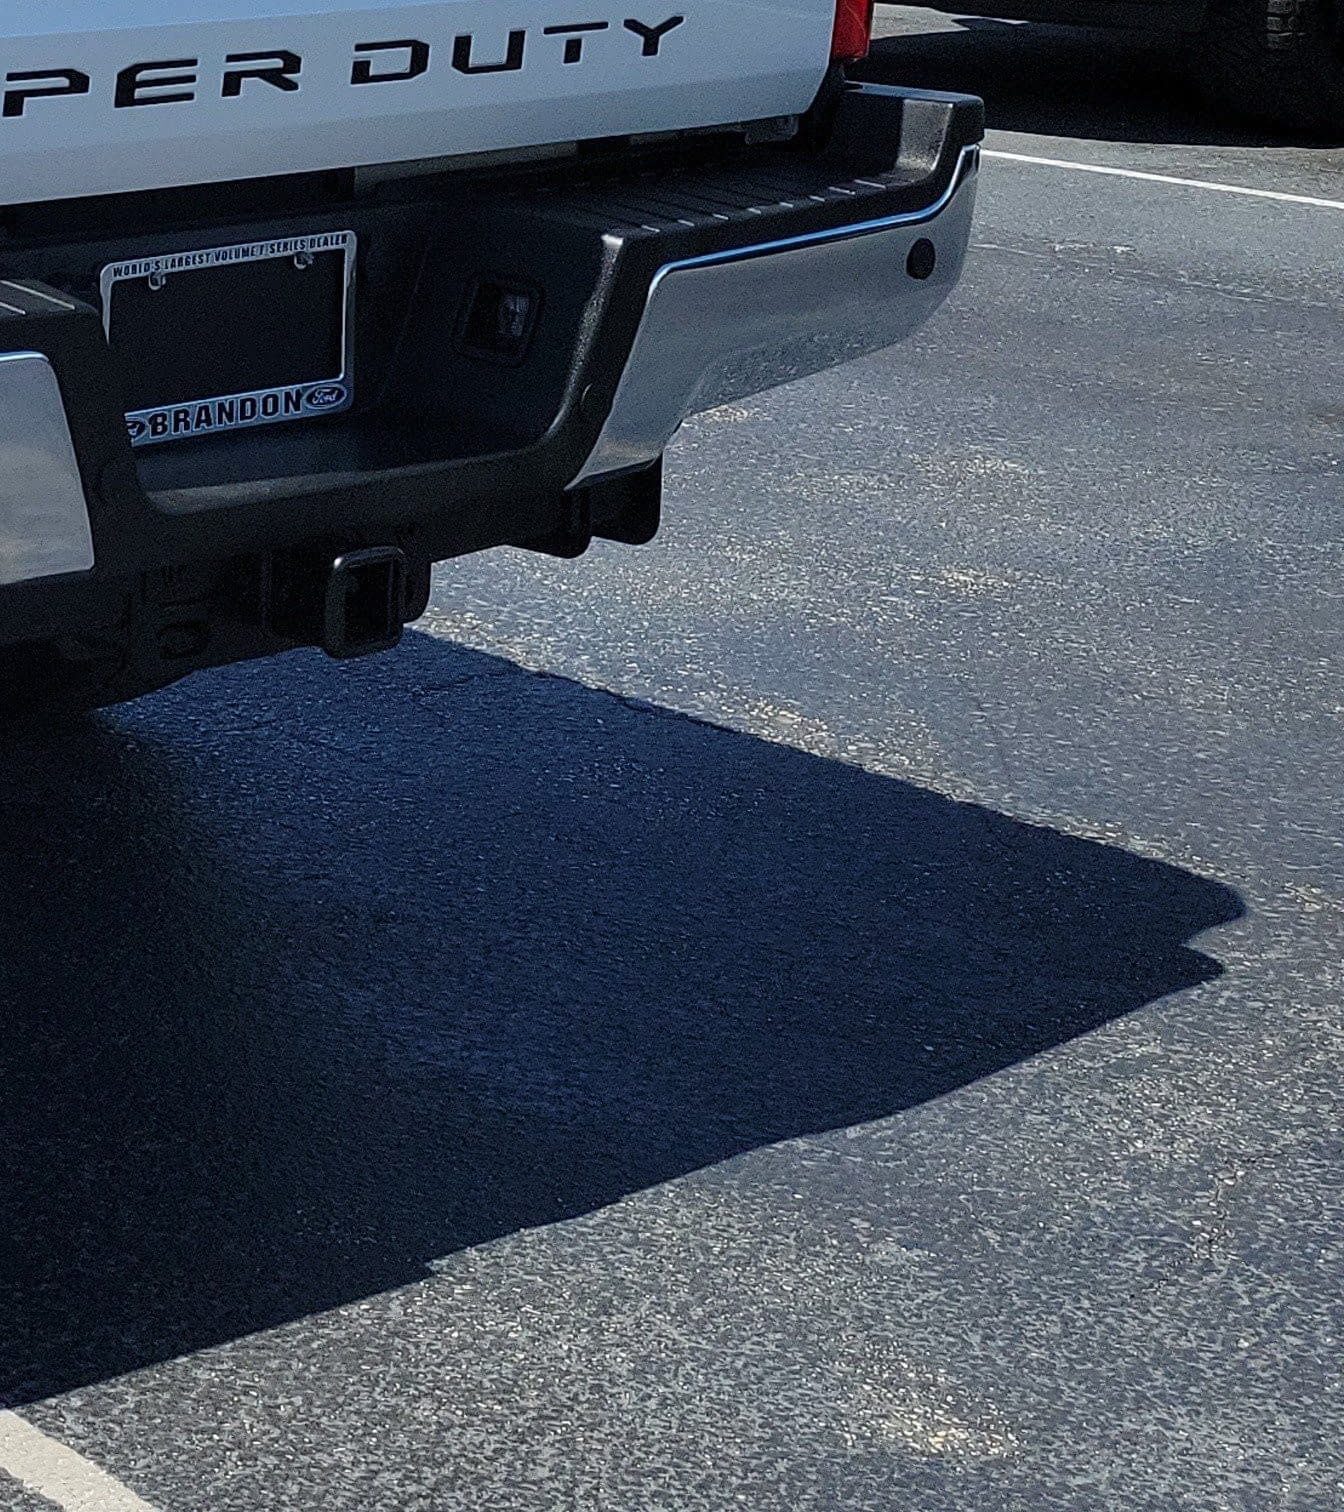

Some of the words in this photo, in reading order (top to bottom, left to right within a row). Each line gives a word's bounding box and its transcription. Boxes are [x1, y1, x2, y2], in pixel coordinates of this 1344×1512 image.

[349, 15, 684, 85] DUTY
[164, 253, 211, 269] LARGEST
[214, 245, 256, 261] VOLUME
[309, 234, 347, 249] DEALER
[148, 390, 301, 438] BRANDON
[313, 390, 338, 403] Ford
